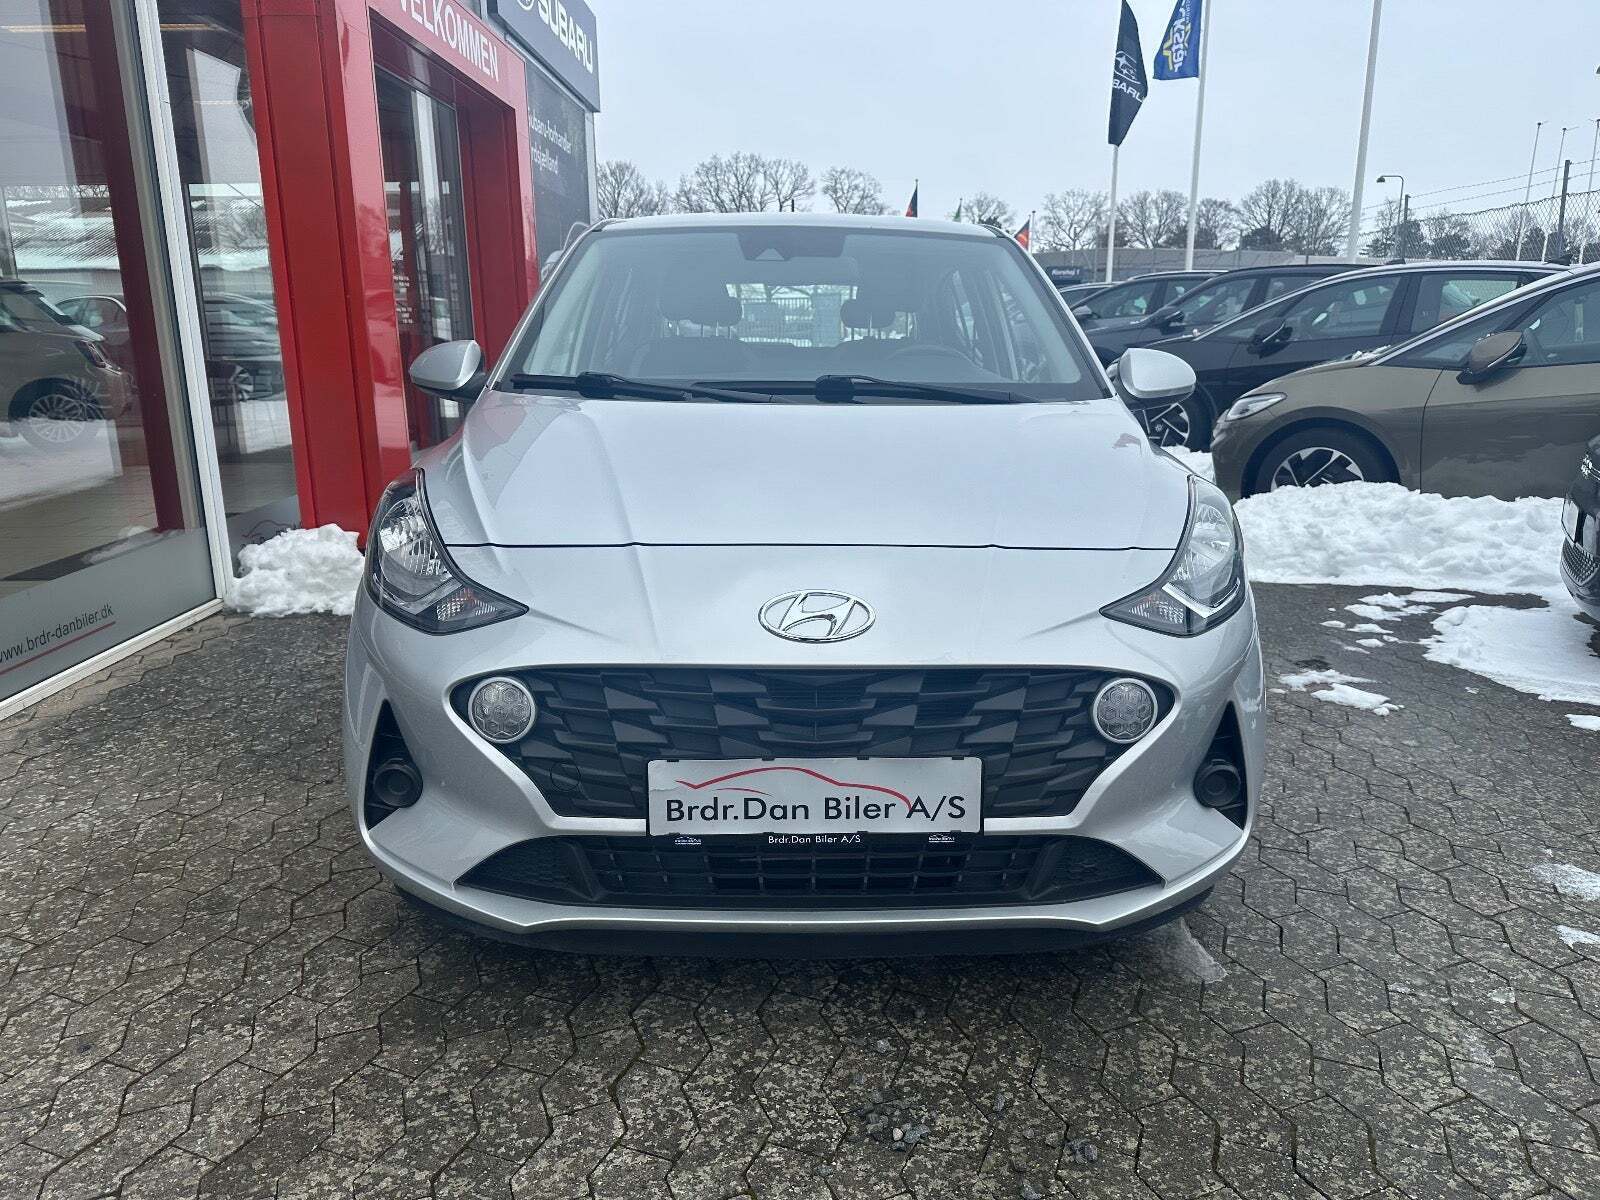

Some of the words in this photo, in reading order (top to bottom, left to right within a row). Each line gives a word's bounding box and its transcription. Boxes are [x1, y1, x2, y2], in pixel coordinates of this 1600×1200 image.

[528, 106, 572, 154] ubaru-forhandler
[666, 796, 809, 821] Brdr.Dan
[824, 795, 897, 820] Biler
[905, 795, 966, 821] A/S
[768, 835, 811, 844] Brdr.Dan
[815, 835, 838, 843] Biler
[841, 834, 861, 844] A/S
